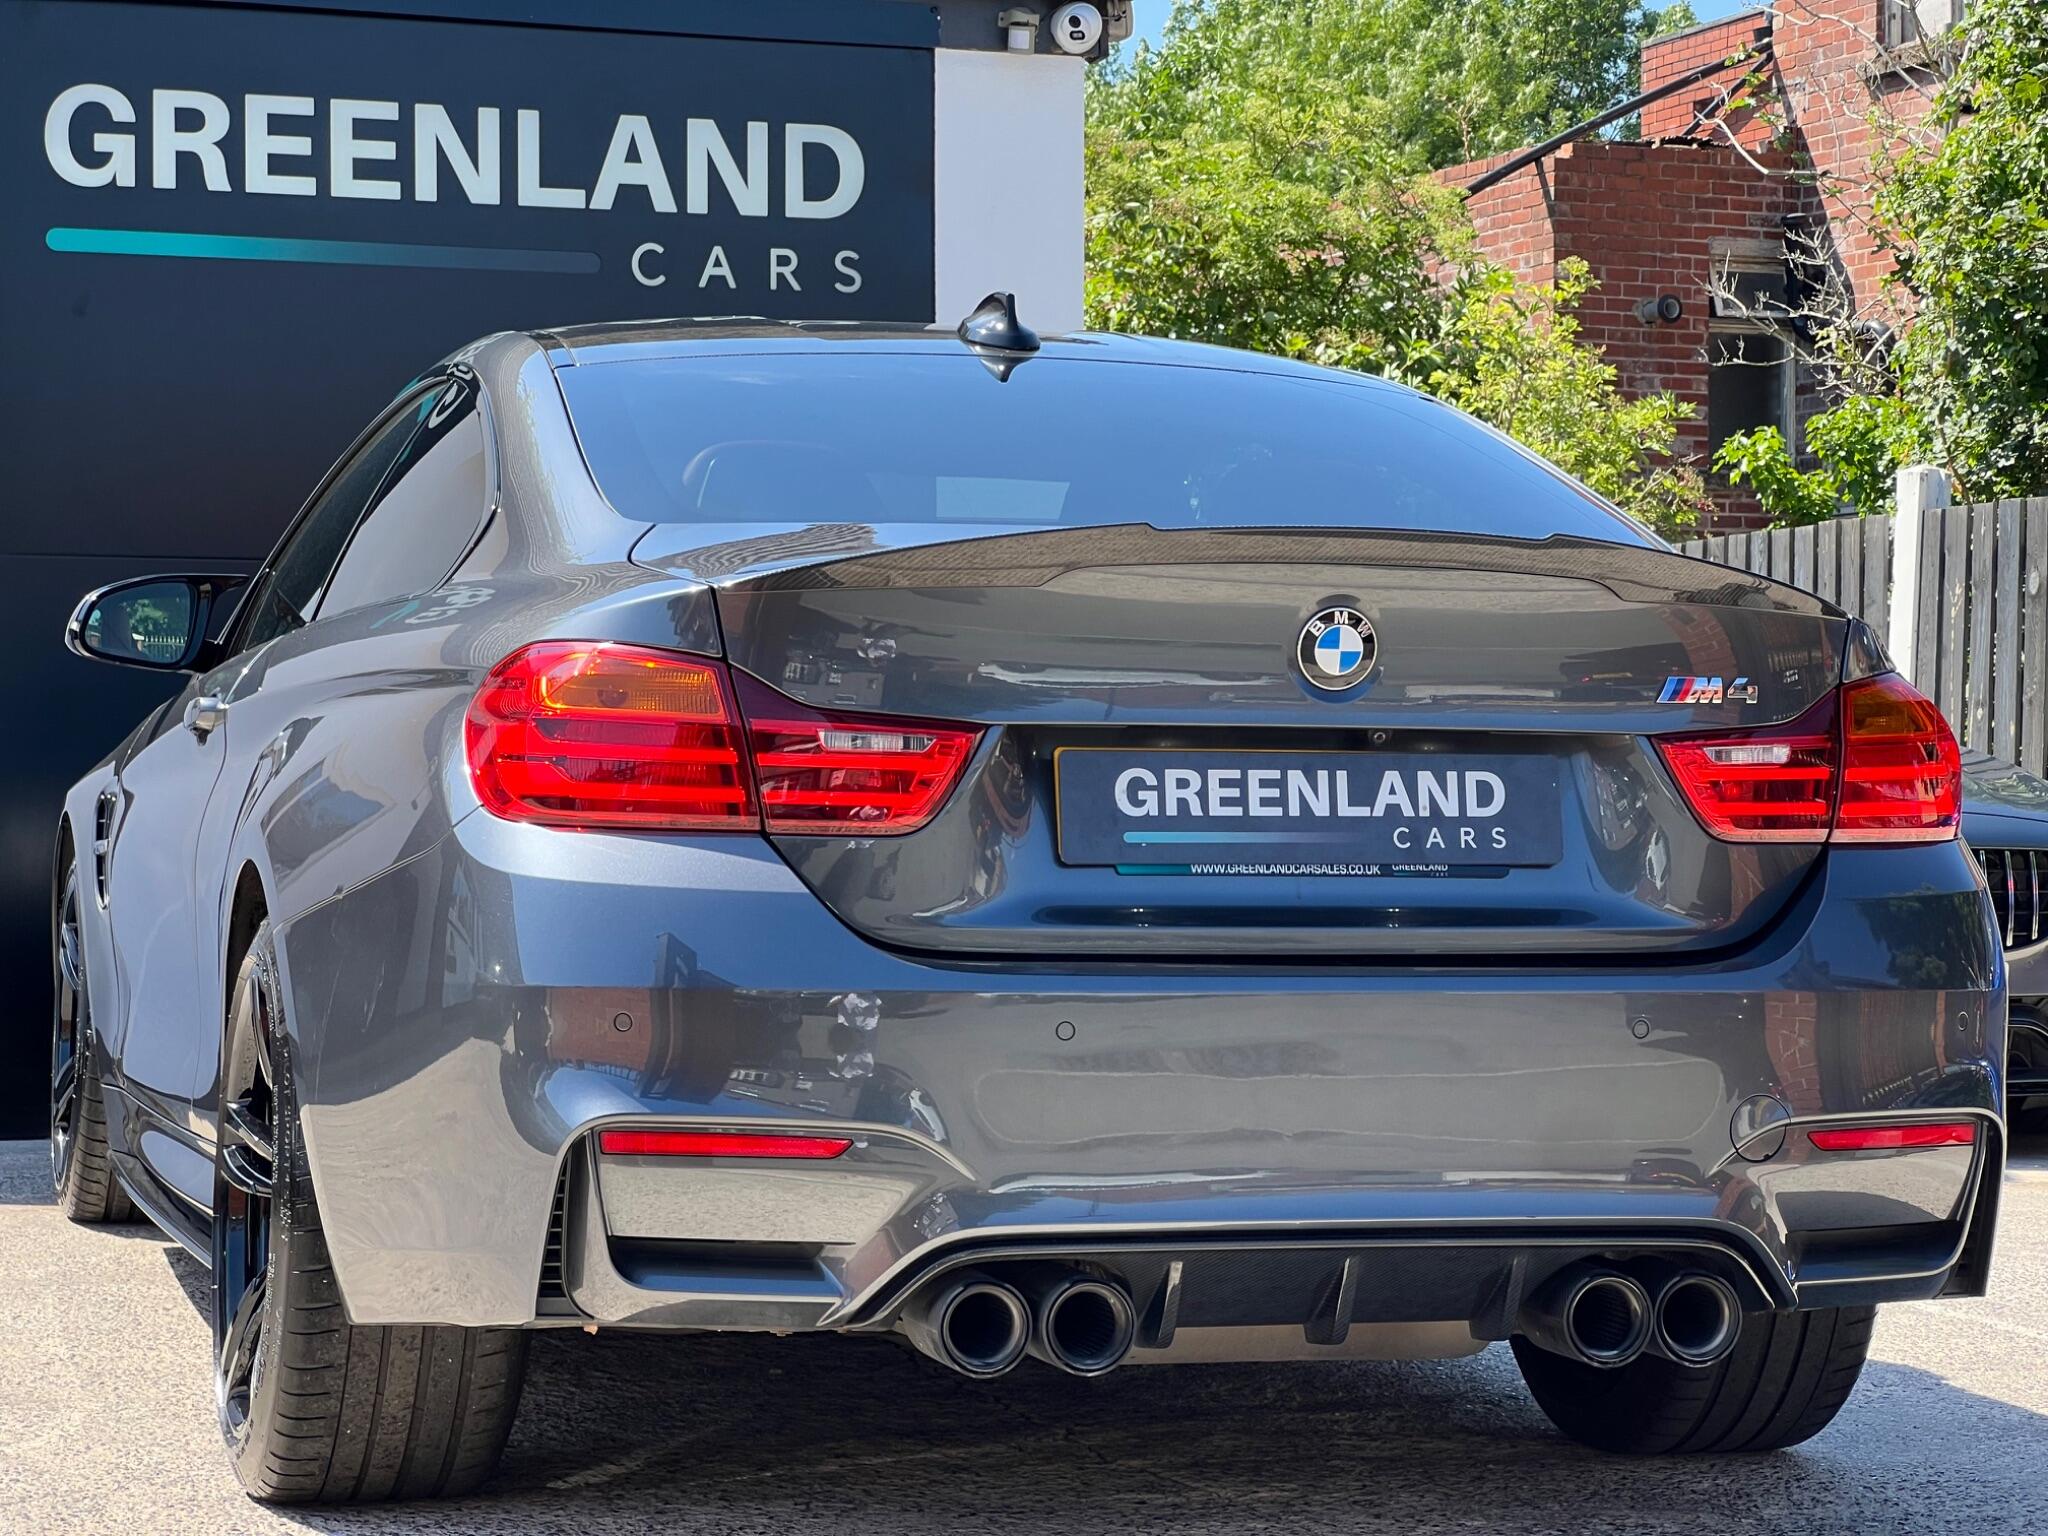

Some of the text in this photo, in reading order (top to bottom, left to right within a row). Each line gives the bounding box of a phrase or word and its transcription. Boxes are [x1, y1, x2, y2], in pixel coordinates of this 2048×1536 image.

[44, 83, 866, 219] GREENLAND
[631, 242, 863, 293] CARS
[1308, 610, 1373, 638] BMW
[1656, 676, 1758, 704] M4
[1114, 767, 1507, 818] GREENLAND
[1393, 826, 1507, 849] CARS
[1190, 863, 1381, 875] WWW.GREENLANDCARSALES.CO.UK
